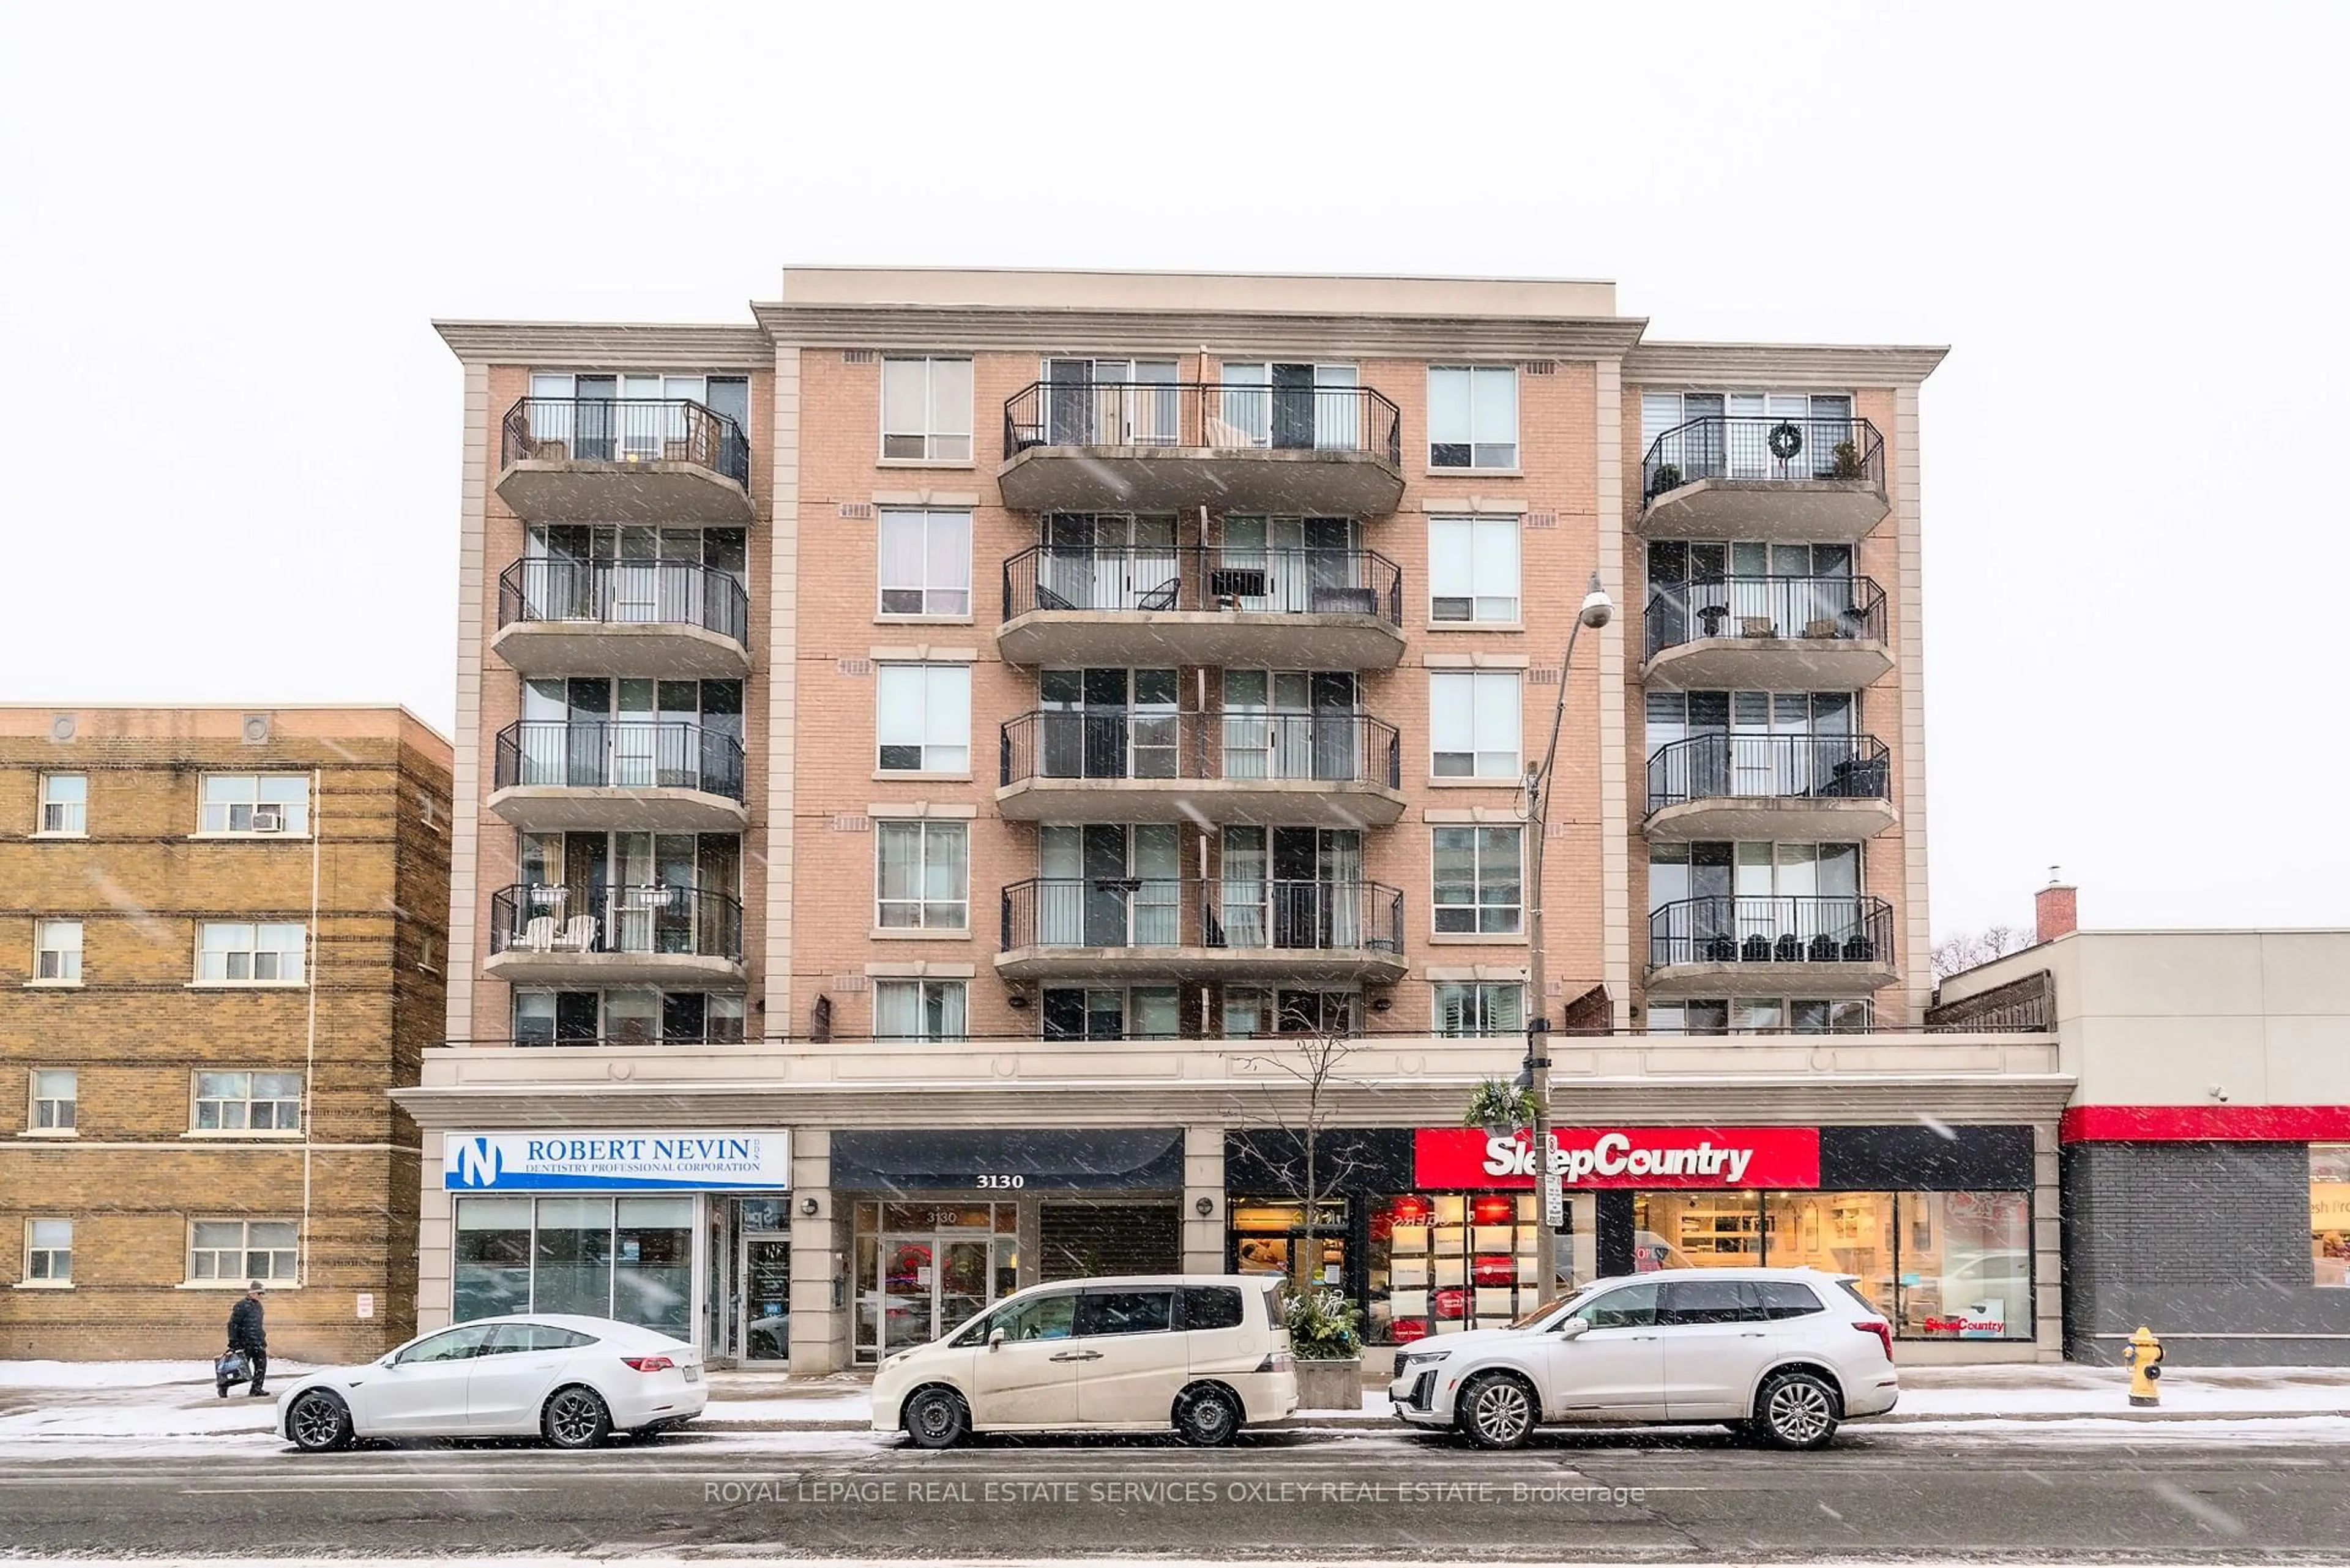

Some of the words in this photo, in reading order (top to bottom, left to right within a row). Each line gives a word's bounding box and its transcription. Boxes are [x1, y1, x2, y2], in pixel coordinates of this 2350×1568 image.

[527, 1139, 646, 1161] ROBERT
[652, 1138, 750, 1160] NEVIN
[526, 1164, 588, 1173] DENTISTRY
[591, 1163, 675, 1173] PROFESSIONAL
[677, 1162, 761, 1172] CORPORATION
[976, 1174, 1024, 1189] 3130
[927, 1212, 958, 1223] 3130
